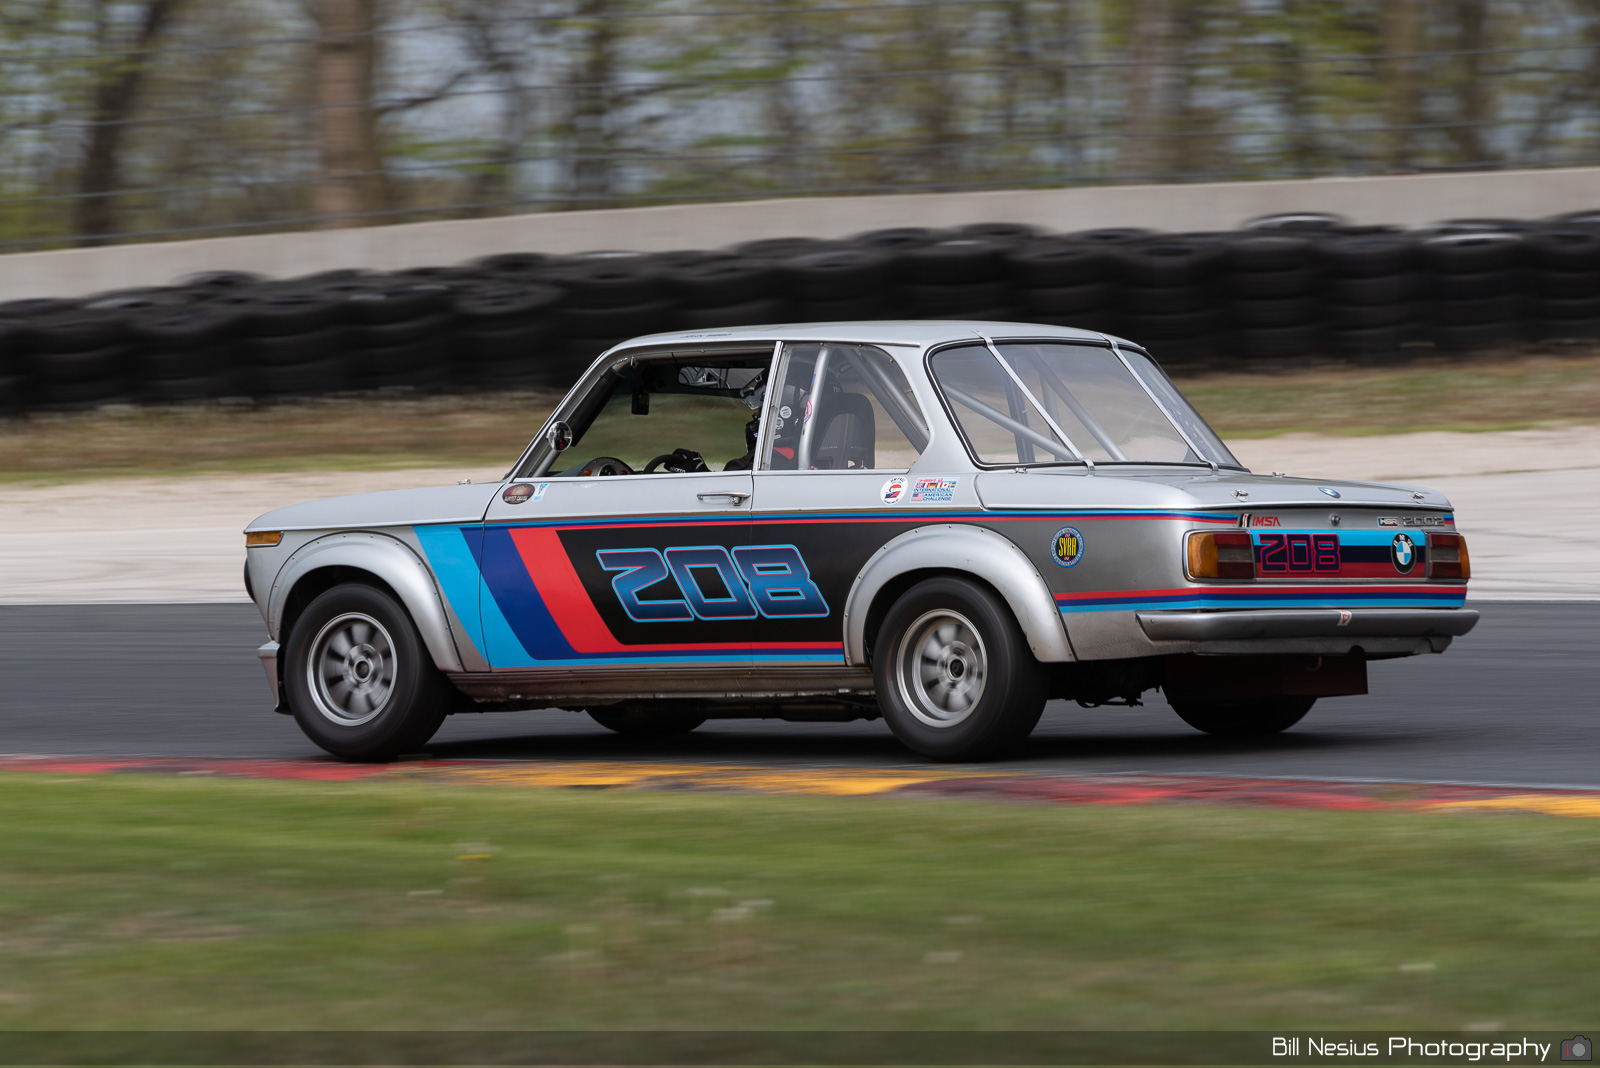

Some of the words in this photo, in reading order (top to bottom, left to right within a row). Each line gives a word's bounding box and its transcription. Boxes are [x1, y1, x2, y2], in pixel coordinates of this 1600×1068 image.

[1252, 515, 1281, 527] IMSA
[1379, 517, 1398, 526] HSR
[1402, 516, 1445, 527] 2002
[1058, 536, 1077, 557] SVRA
[1258, 532, 1342, 573] 208
[596, 544, 830, 623] 208
